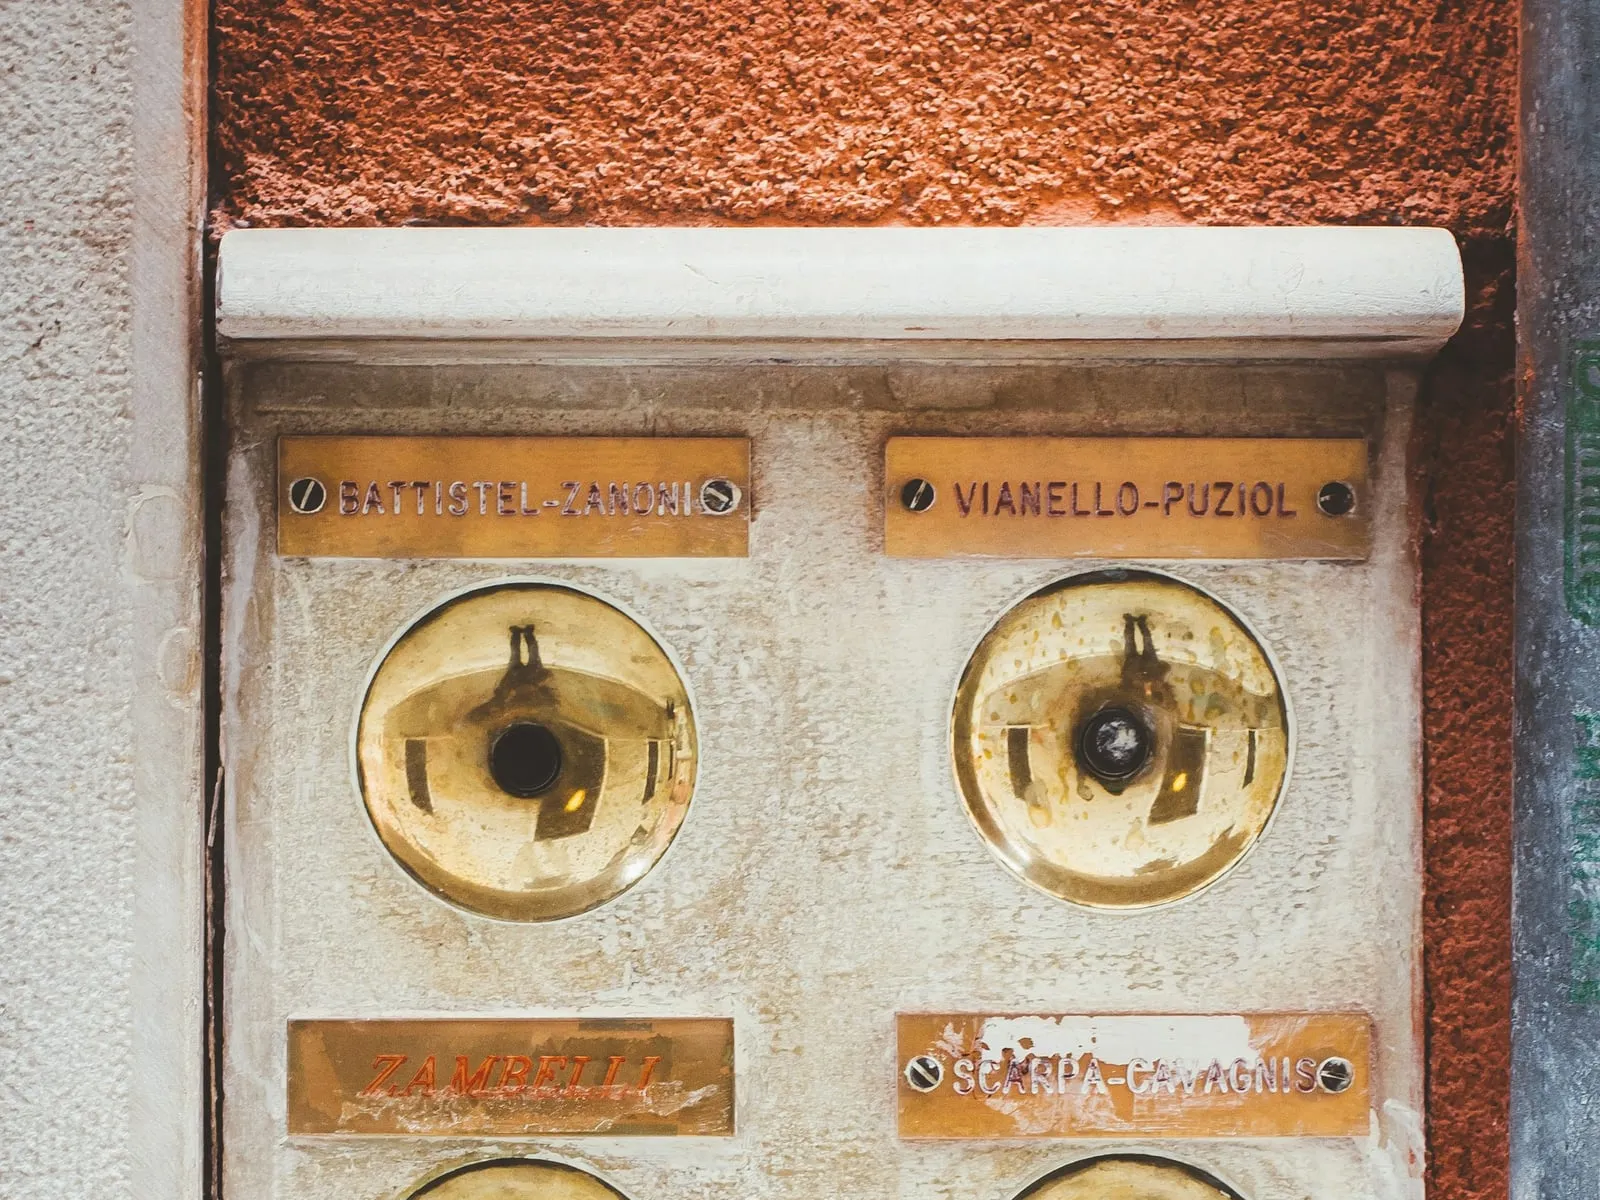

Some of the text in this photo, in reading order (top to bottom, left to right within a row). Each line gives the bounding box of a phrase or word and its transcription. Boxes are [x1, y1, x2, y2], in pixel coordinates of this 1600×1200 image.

[338, 480, 692, 516] BATTISTEL-ZANONI
[953, 480, 1298, 518] VIANELLO-PUZIOL
[355, 1053, 663, 1100] ZAMBELLI
[952, 1055, 1317, 1096] SCARPA-CAVAGNIS
